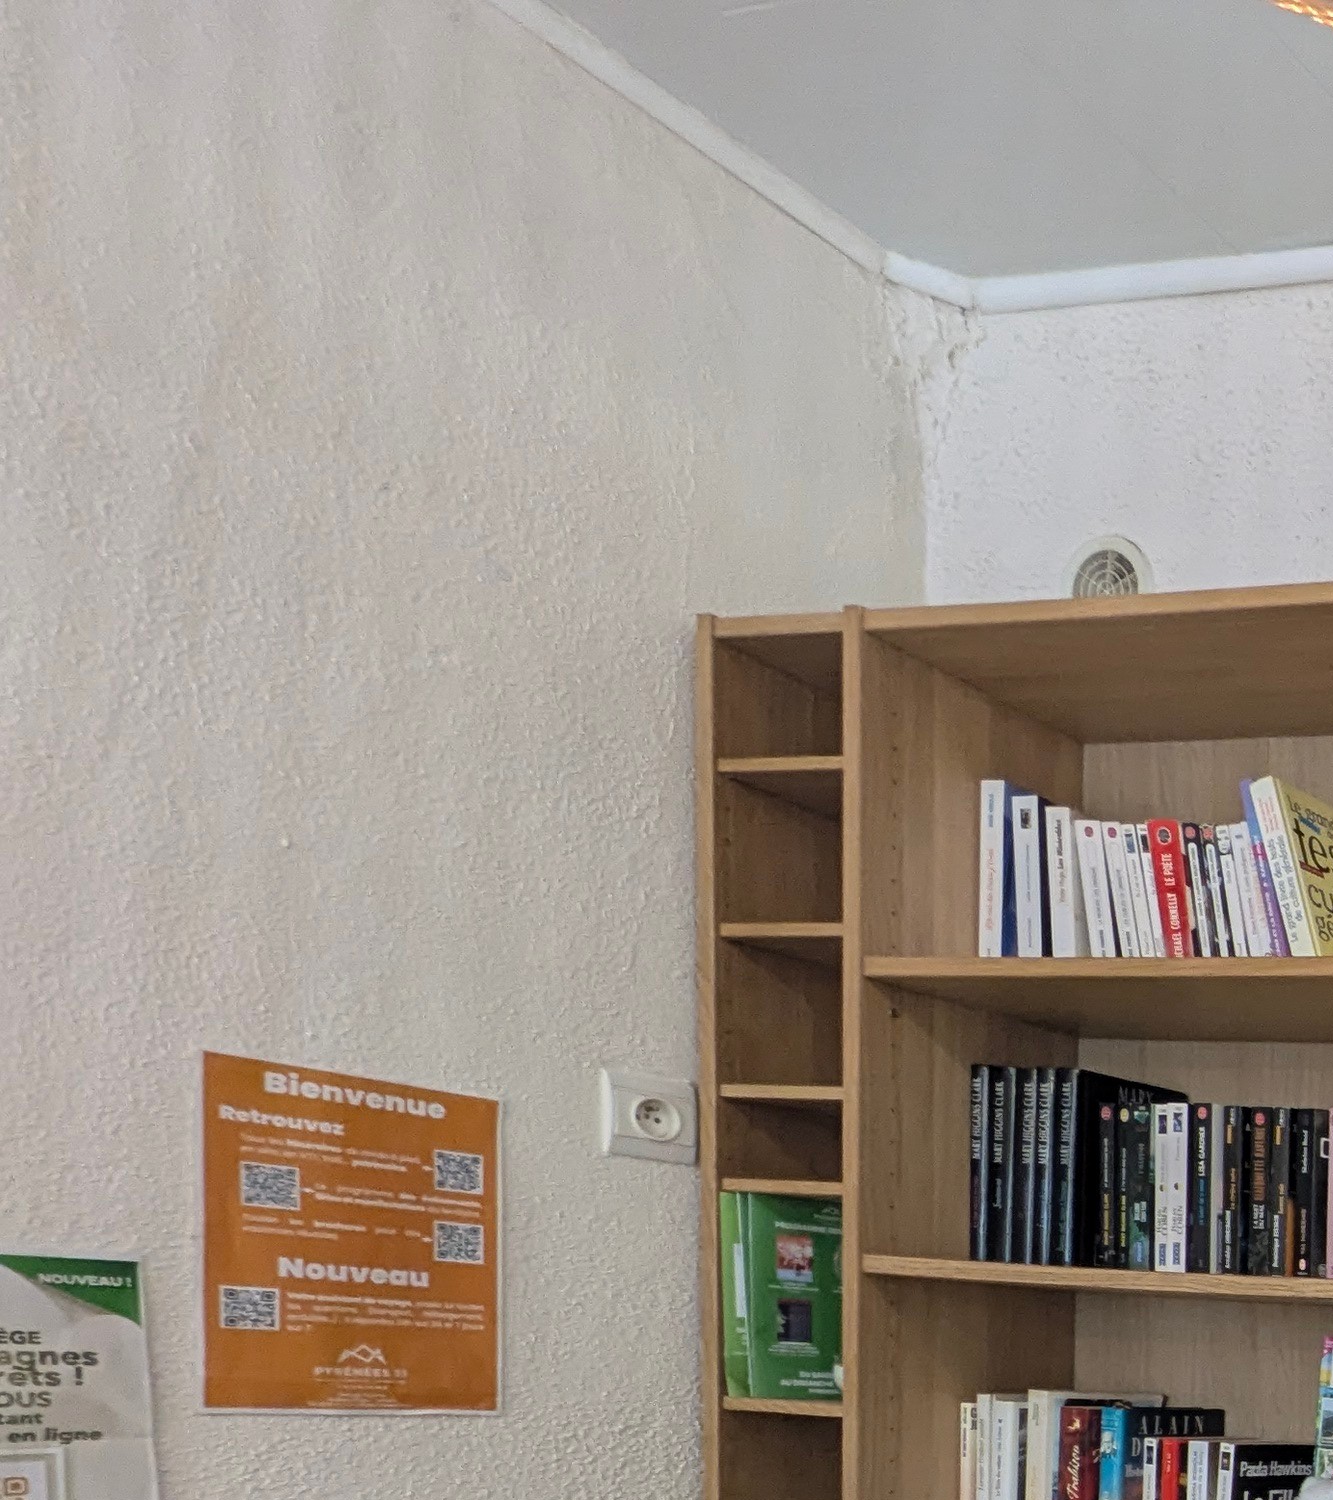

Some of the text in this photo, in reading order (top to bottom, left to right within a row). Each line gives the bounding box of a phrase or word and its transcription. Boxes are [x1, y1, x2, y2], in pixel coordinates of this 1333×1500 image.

[1163, 876, 1174, 886] LE
[263, 1071, 446, 1119] Bienvenue
[971, 1077, 982, 1158] MARY HIGGINS CLARK
[218, 1104, 345, 1136] Retrouvez
[992, 1081, 1004, 1162] MARY HIGGINS CLARK
[1020, 1082, 1034, 1163] MARY HIGGINS CLARK
[1035, 1082, 1050, 1164] MARY HIGGINS CLARK
[1058, 1082, 1072, 1164] MARY HIGGINS CLARK
[37, 1272, 123, 1287] NOUVEAU
[277, 1256, 429, 1288] Nouveau
[1138, 1414, 1204, 1436] ALAIN
[1064, 1444, 1081, 1498] Trahison
[1240, 1460, 1313, 1477] Paula Hawkins
